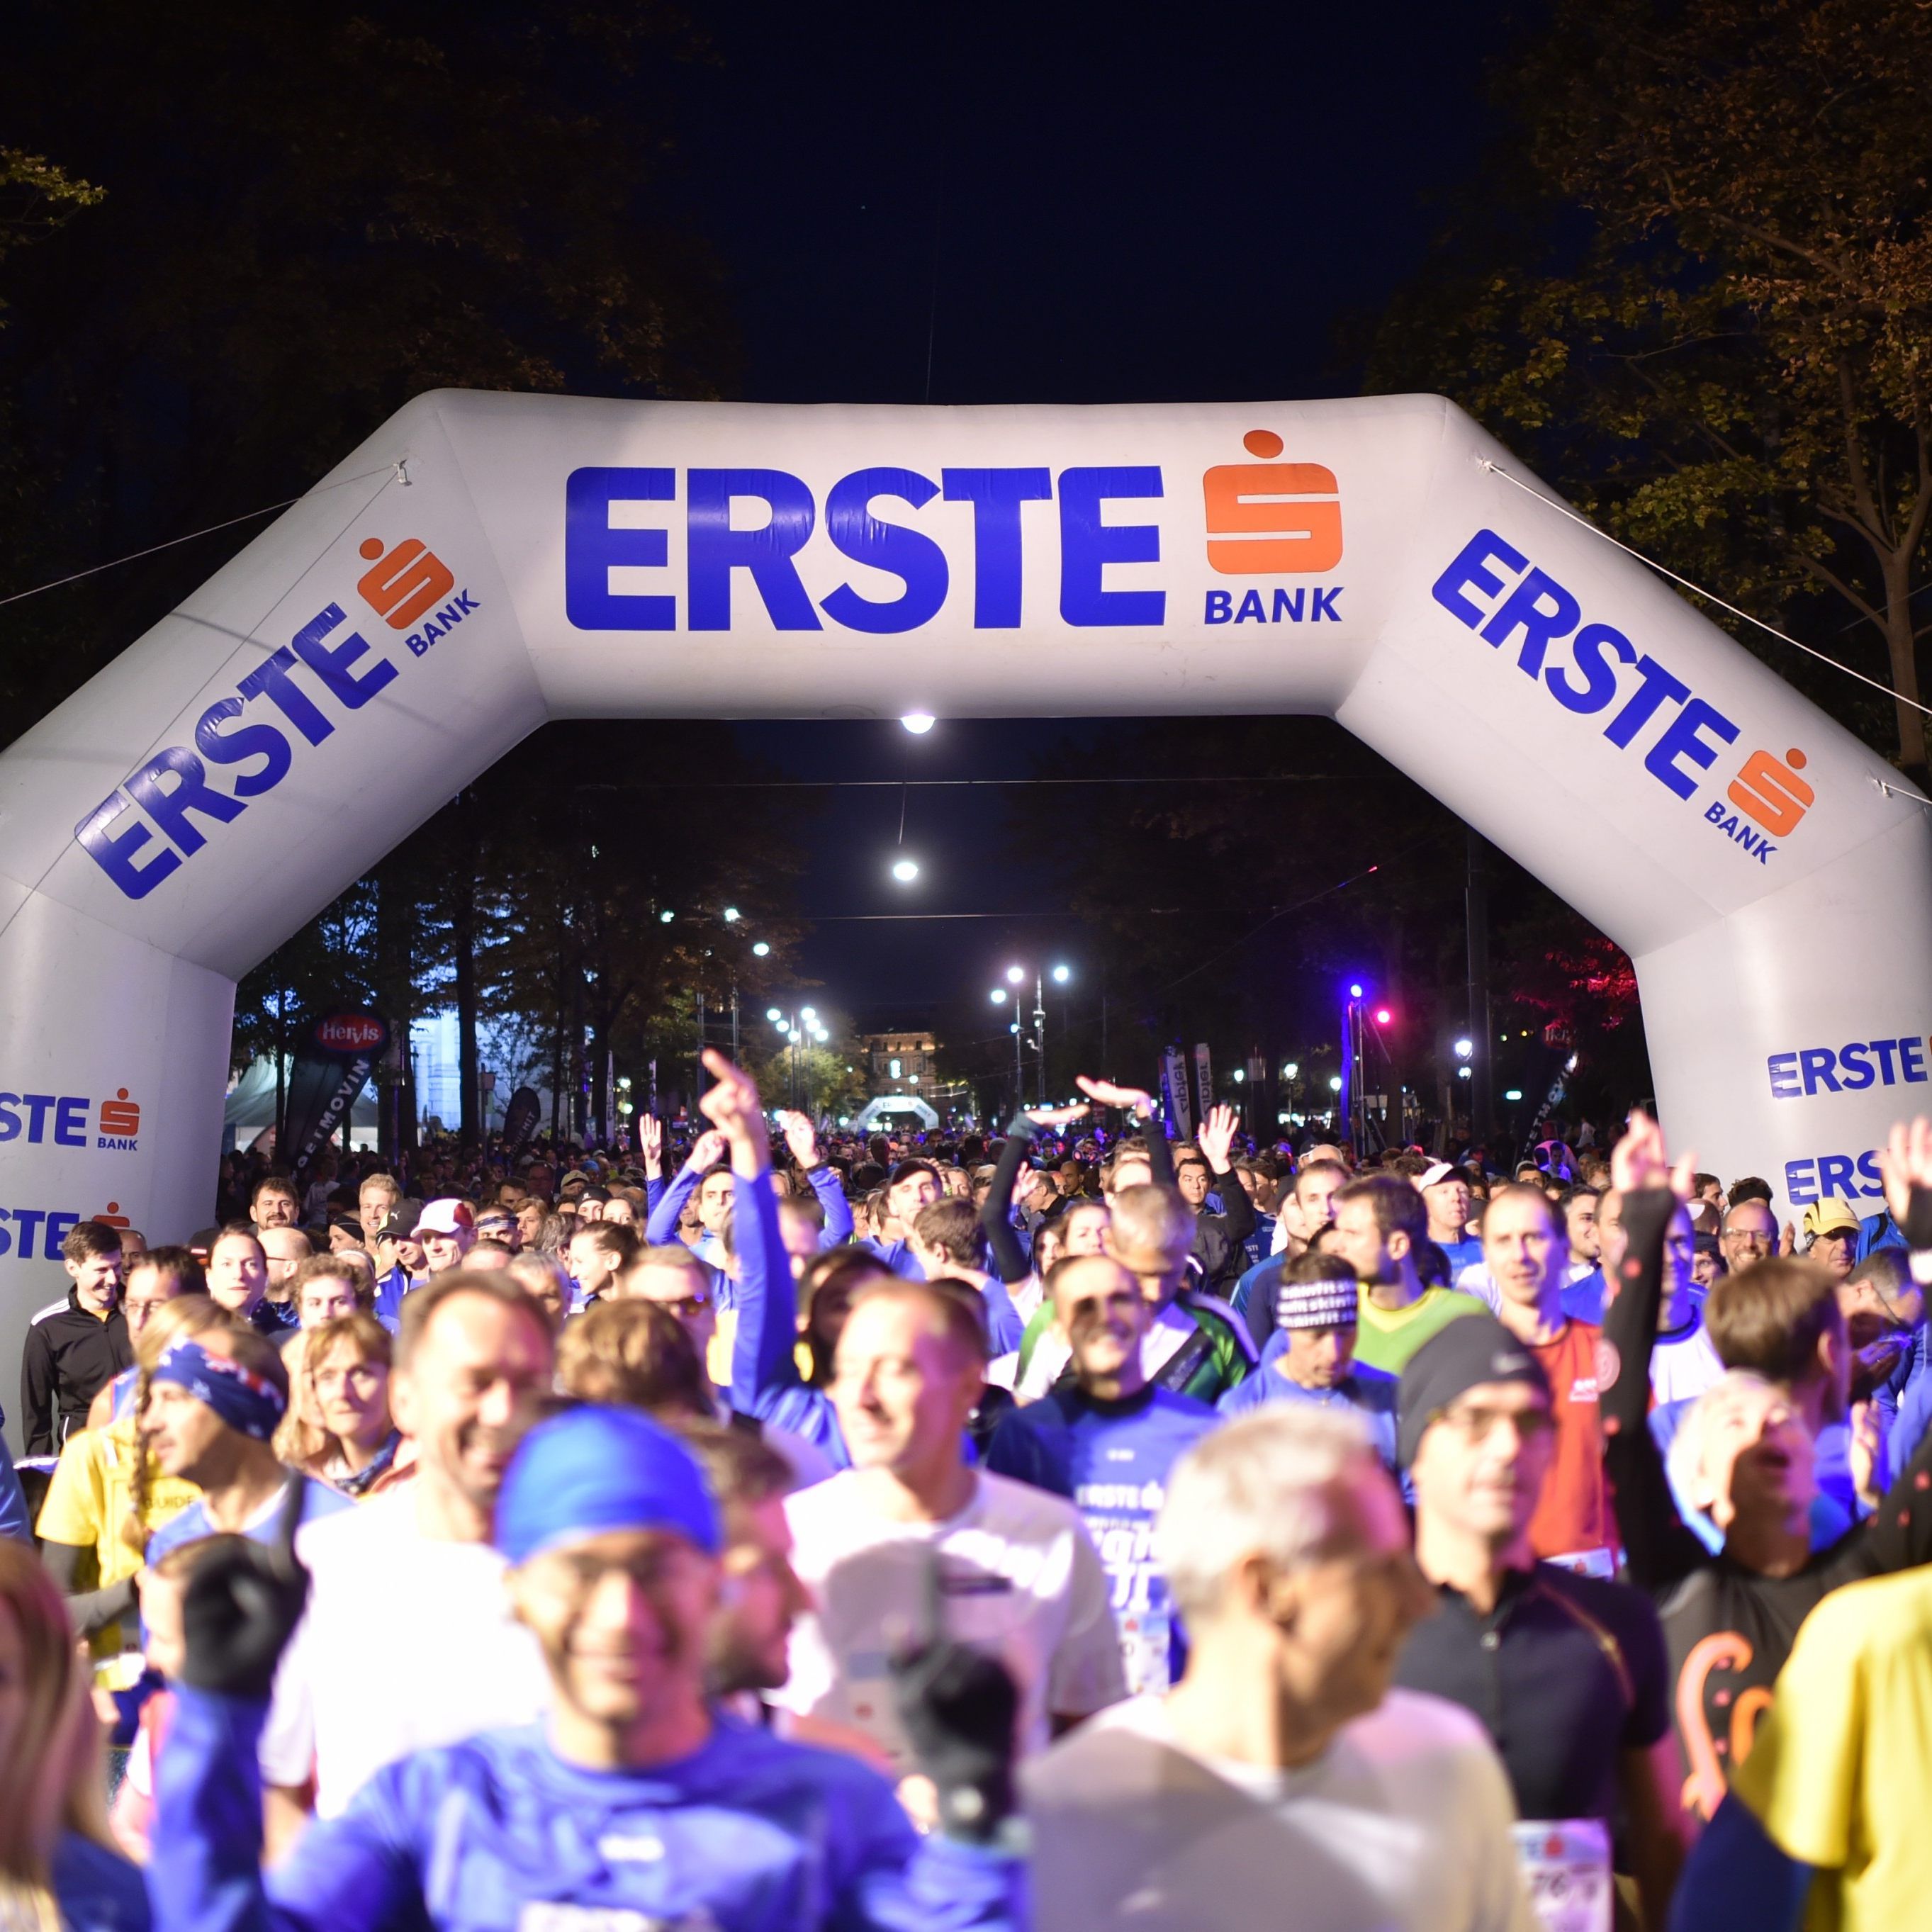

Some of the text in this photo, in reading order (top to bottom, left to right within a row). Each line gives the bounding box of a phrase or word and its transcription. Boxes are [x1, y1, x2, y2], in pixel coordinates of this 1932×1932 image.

[566, 466, 1167, 634] ERSTE
[404, 588, 481, 658] BANK
[1203, 587, 1344, 624] BANK
[1432, 528, 1741, 802] ERSTE
[74, 602, 400, 900] ERSTE
[1704, 801, 1777, 865] BANK
[322, 1021, 380, 1044] Hervis
[1768, 1036, 1928, 1099] ERSTE
[97, 1137, 138, 1152] BANK
[1785, 1150, 1885, 1206] ERS
